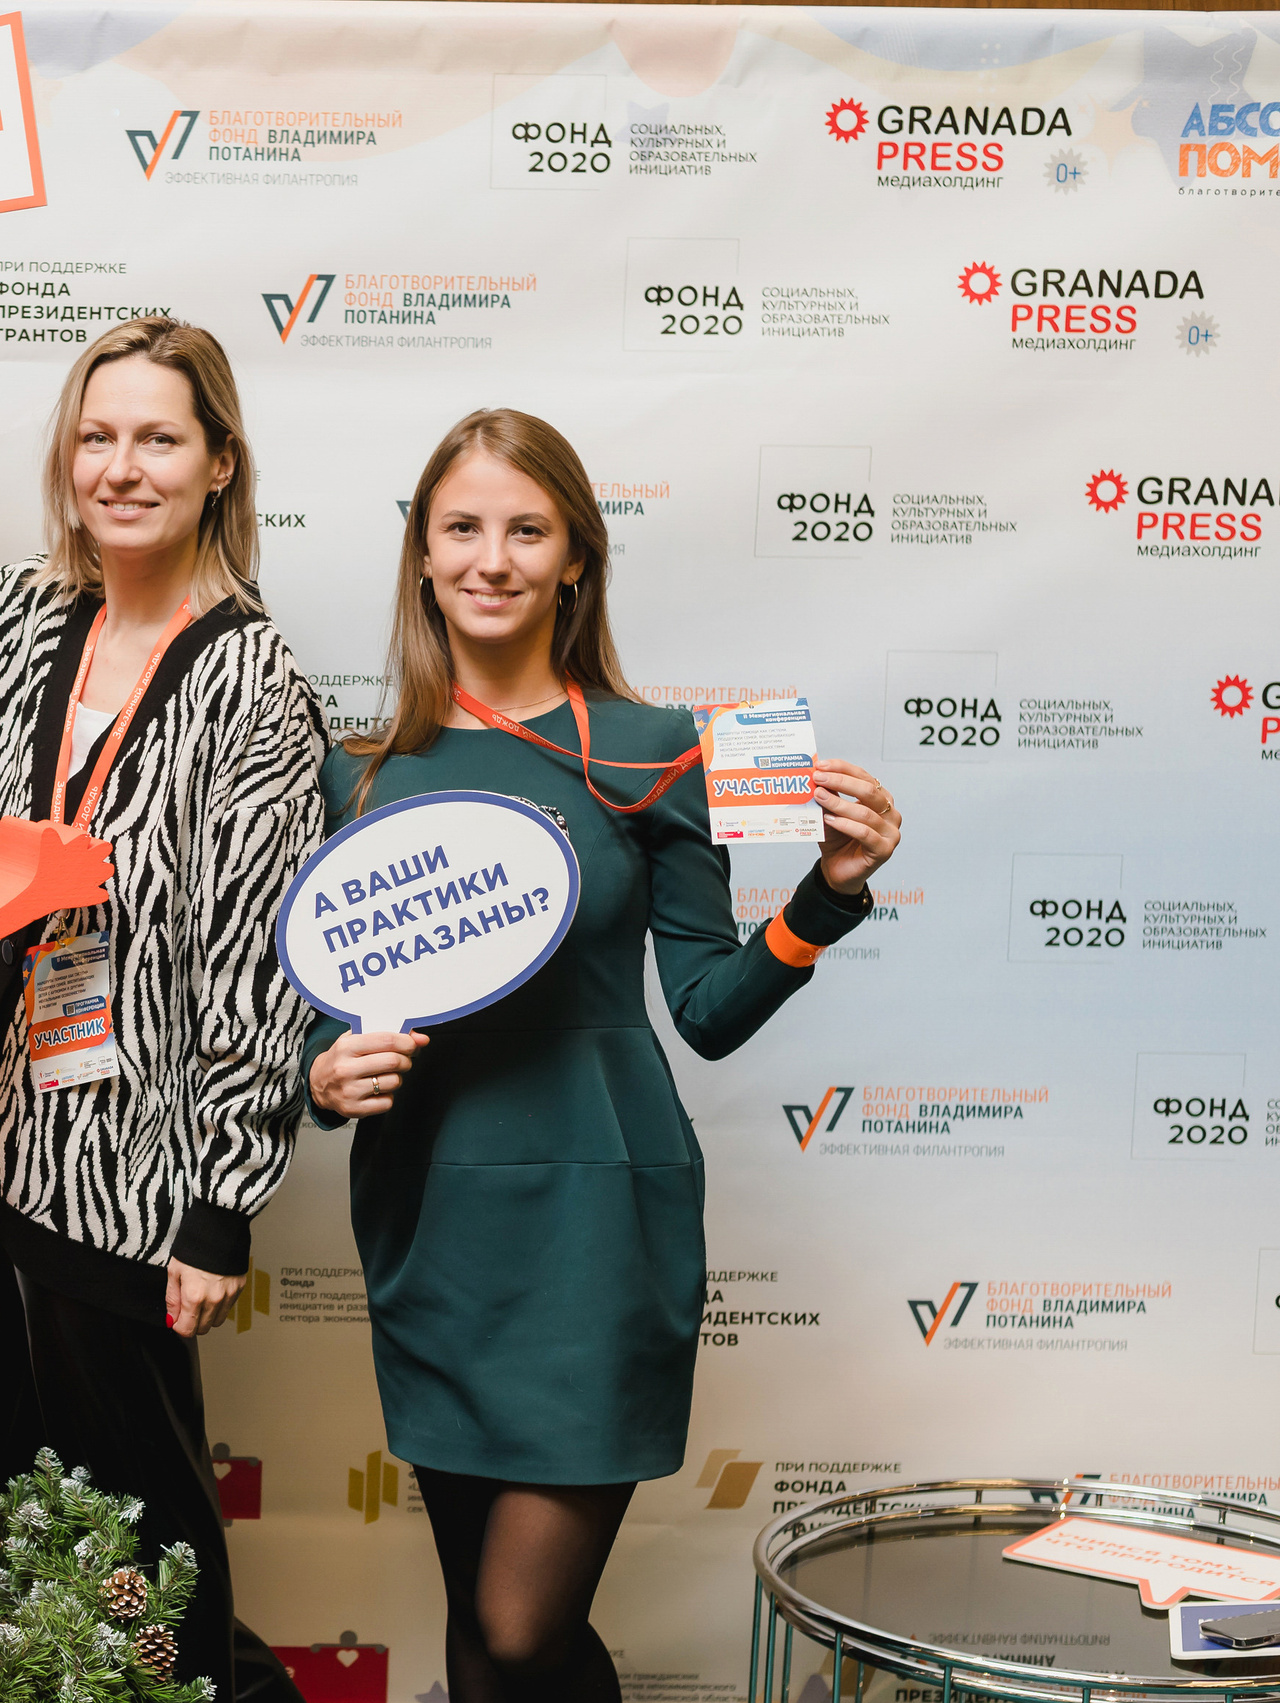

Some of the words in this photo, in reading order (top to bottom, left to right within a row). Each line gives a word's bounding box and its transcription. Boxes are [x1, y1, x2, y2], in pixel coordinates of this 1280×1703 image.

[209, 110, 402, 128] БЛАГОТВОРИТЕЛЬНЫЙ
[877, 105, 1073, 137] GRANADA
[208, 128, 259, 144] ФОНД
[268, 130, 377, 146] ВЛАДИМИРА
[512, 122, 612, 148] ФОНД
[630, 123, 725, 137] СОЦИАЛЬНЫХ,
[630, 138, 713, 149] КУЛЬТУРНЫХ
[208, 146, 302, 163] ПОТАНИНА
[528, 151, 611, 173] 2020
[629, 151, 757, 163] ОБРАЗОВАТЕЛЬНЫХ
[877, 142, 1004, 172] PRESS
[165, 171, 261, 185] ЭФФЕКТИВНАЯ
[263, 173, 358, 187] ФИЛАНТРОПИЯ
[629, 164, 712, 176] ИНИЦИАТИВ
[1056, 163, 1081, 183] 0+
[877, 174, 1003, 190] медиахолдинг
[28, 261, 127, 274] ПОДДЕРЖКЕ
[344, 273, 537, 293] БЛАГОТВОРИТЕЛЬНЫЙ
[1010, 268, 1205, 300] GRANADA
[344, 292, 394, 308] ФОНД
[403, 293, 511, 310] ВЛАДИМИРА
[644, 285, 744, 311] ФОНД
[761, 286, 859, 300] СОЦИАЛЬНЫХ,
[761, 300, 846, 312] КУЛЬТУРНЫХ
[344, 309, 436, 326] ПОТАНИНА
[661, 314, 743, 336] 2020
[761, 313, 890, 325] ОБРАЗОВАТЕЛЬНЫХ
[1011, 304, 1137, 334] PRESS
[761, 326, 845, 339] ИНИЦИАТИВ
[1188, 326, 1213, 345] 0+
[301, 334, 394, 348] ЭФФЕКТИВНАЯ
[397, 335, 493, 350] ФИЛАНТРОПИЯ
[1012, 337, 1136, 352] медиахолдинг
[777, 493, 875, 518] ФОНД
[892, 493, 988, 507] СОЦИАЛЬНЫХ,
[892, 506, 976, 519] КУЛЬТУРНЫХ
[792, 521, 874, 542] 2020
[892, 520, 1017, 532] ОБРАЗОВАТЕЛЬНЫХ
[1136, 512, 1262, 542] PRESS
[891, 532, 972, 544] ИНИЦИАТИВ
[1136, 544, 1261, 559] медиахолдинг
[904, 698, 1001, 722] ФОНД
[919, 726, 1000, 746] 2020
[714, 776, 811, 797] УЧАСТНИК
[314, 891, 338, 919] А
[342, 845, 450, 906] ВАШИ
[322, 862, 509, 953] ПРАКТИКИ
[1030, 899, 1127, 923] ФОНД
[1143, 901, 1238, 914] СОЦИАЛЬНЫХ,
[1143, 914, 1226, 925] КУЛЬТУРНЫХ
[338, 887, 549, 993] ДОКАЗАНЫ?
[1045, 926, 1124, 948] 2020
[1142, 926, 1267, 938] ОБРАЗОВАТЕЛЬНЫХ
[1142, 938, 1223, 950] ИНИЦИАТИВ
[35, 1017, 105, 1049] УЧАСТНИК
[862, 1086, 1049, 1104] БЛАГОТВОРИТЕЛЬНЫЙ
[862, 1103, 909, 1119] ФОНД
[919, 1104, 1023, 1120] ВЛАДИМИРА
[1152, 1097, 1250, 1121] ФОНД
[862, 1119, 951, 1135] ПОТАНИНА
[1168, 1125, 1248, 1145] 2020
[987, 1281, 1171, 1299] БЛАГОТВОРИТЕЛЬНЫЙ
[986, 1298, 1034, 1314] ФОНД
[1042, 1299, 1146, 1315] ВЛАДИМИРА
[985, 1314, 1074, 1329] ПОТАНИНА
[1055, 1532, 1161, 1556] УЧИМСЯ
[1170, 1554, 1244, 1573] ТОМУ,
[1045, 1537, 1095, 1551] ЧТО
[1100, 1549, 1275, 1587] ПРИГОДИТСЯ
